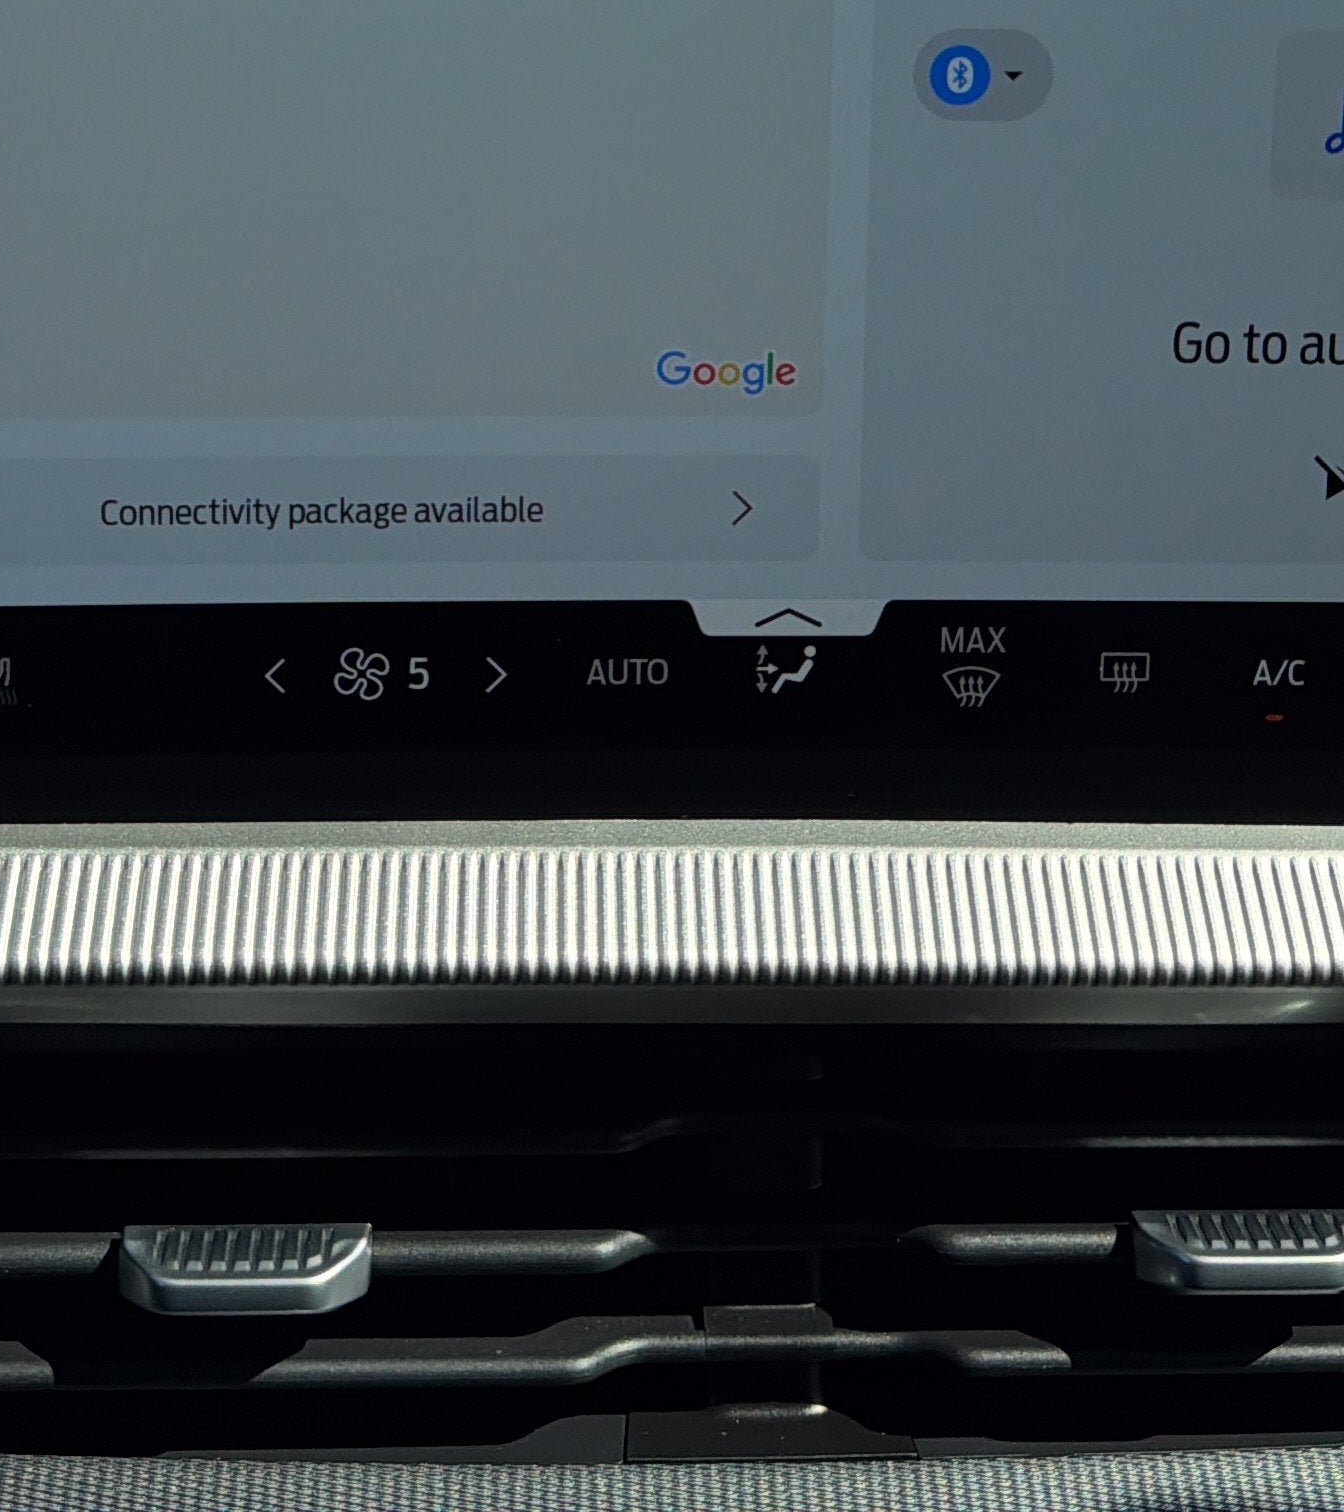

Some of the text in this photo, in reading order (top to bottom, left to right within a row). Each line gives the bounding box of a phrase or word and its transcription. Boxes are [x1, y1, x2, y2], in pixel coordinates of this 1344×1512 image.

[1173, 321, 1231, 364] Go
[1243, 324, 1288, 365] to
[656, 349, 797, 397] Google
[100, 494, 544, 531] Connectivity package available
[940, 626, 1007, 654] MAX
[408, 656, 430, 690] 5
[586, 658, 670, 686] AUTO
[1252, 659, 1306, 687] A/C
